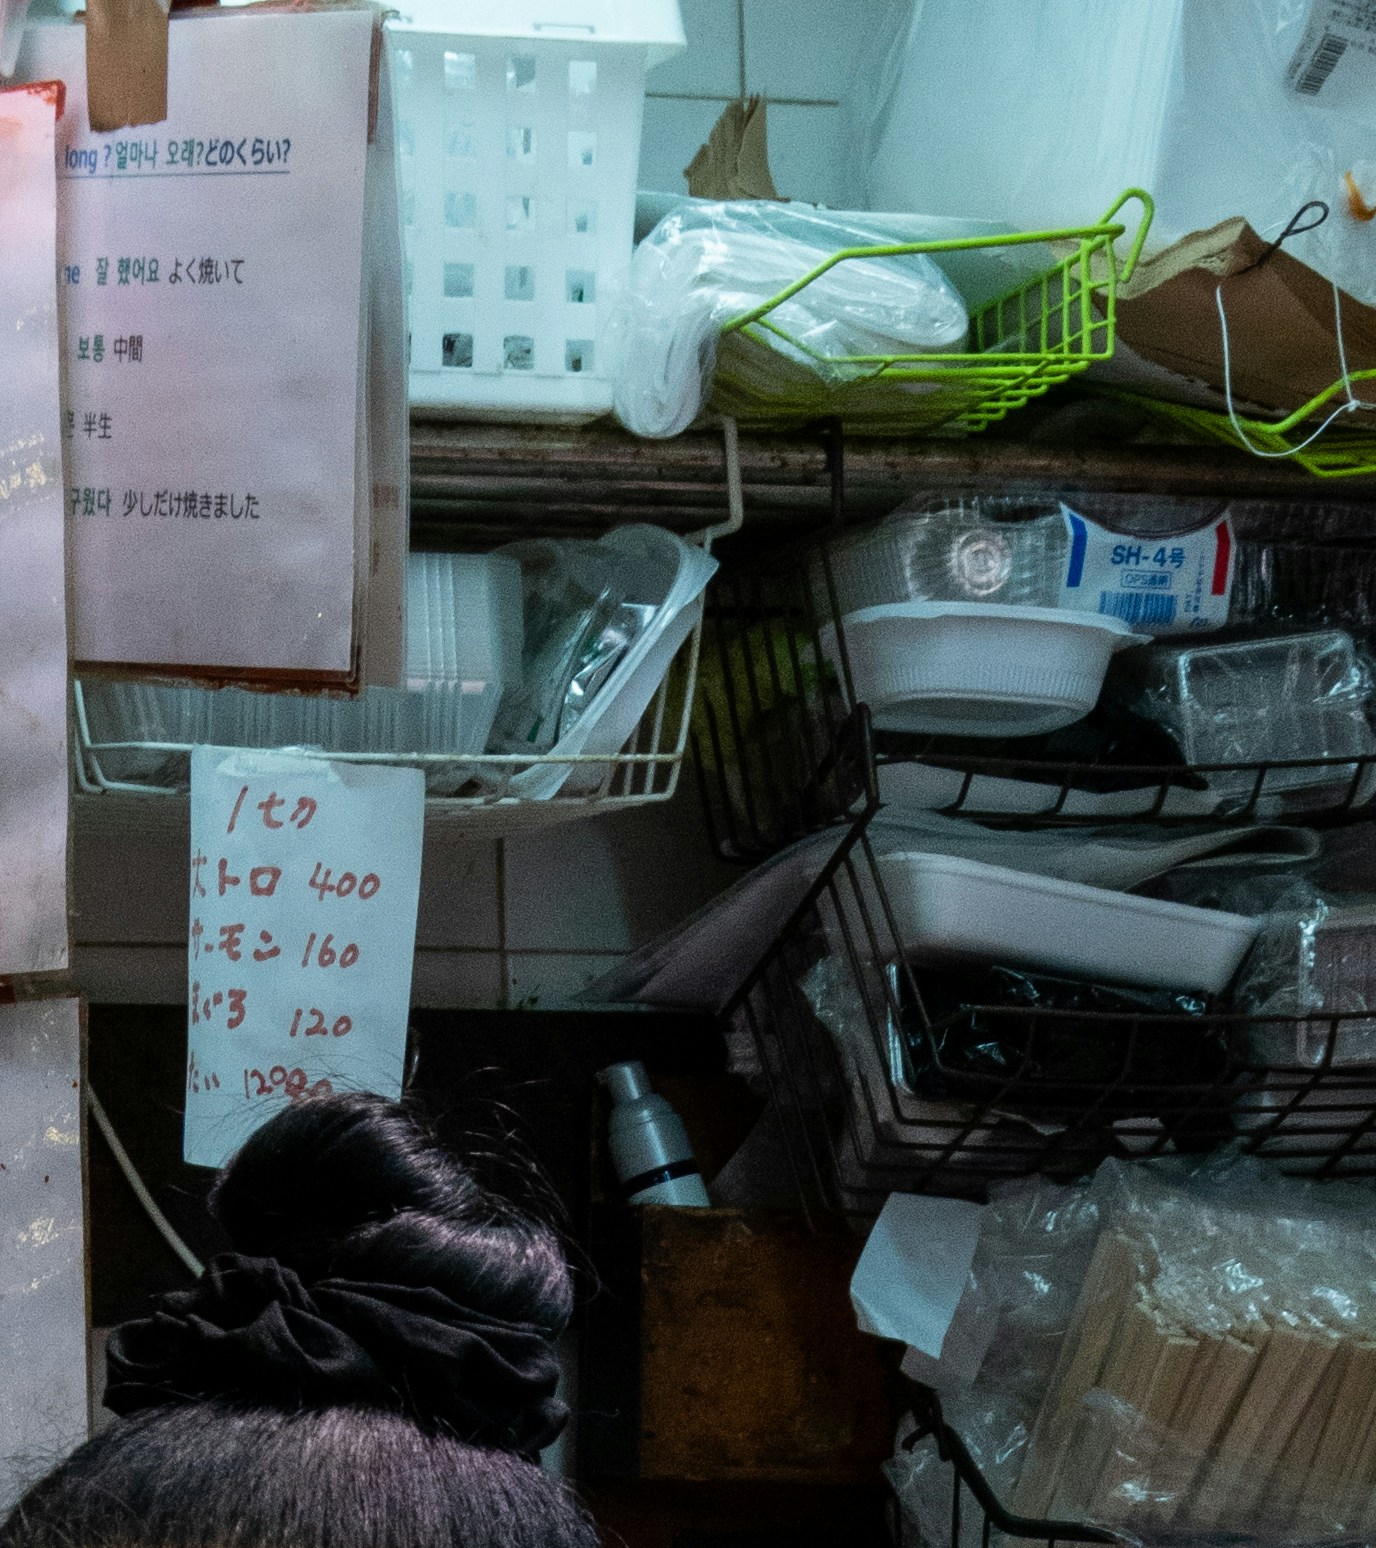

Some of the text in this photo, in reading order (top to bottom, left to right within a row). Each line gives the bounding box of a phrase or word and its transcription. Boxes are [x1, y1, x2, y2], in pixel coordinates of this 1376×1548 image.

[168, 256, 246, 287] よく焼いて
[113, 333, 144, 363] 中間
[82, 410, 113, 441] 半生
[121, 487, 261, 522] 少しだけ焼きました
[308, 860, 382, 902] 400
[300, 931, 361, 969] 160
[288, 1007, 354, 1039] 120
